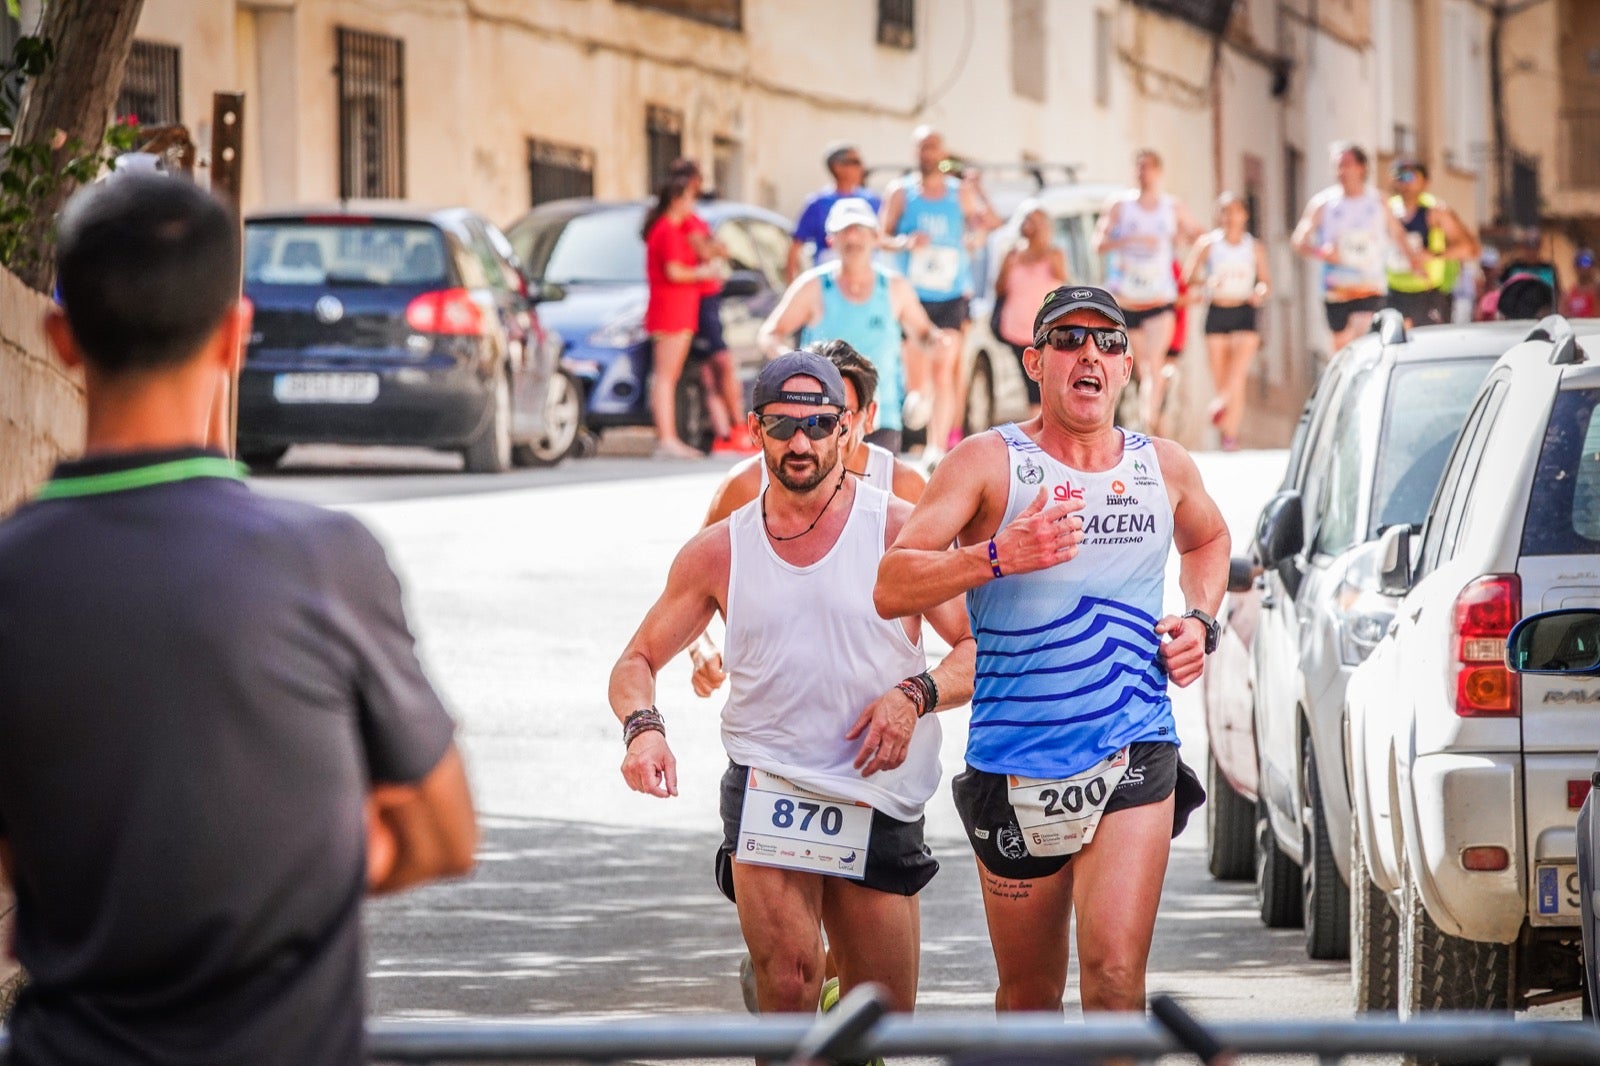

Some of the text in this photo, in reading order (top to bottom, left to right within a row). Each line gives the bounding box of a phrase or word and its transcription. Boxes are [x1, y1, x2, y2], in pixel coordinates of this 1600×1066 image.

[1091, 536, 1144, 545] ATLETISMO
[1039, 776, 1107, 817] 200
[771, 798, 843, 836] 870
[1544, 895, 1553, 907] E
